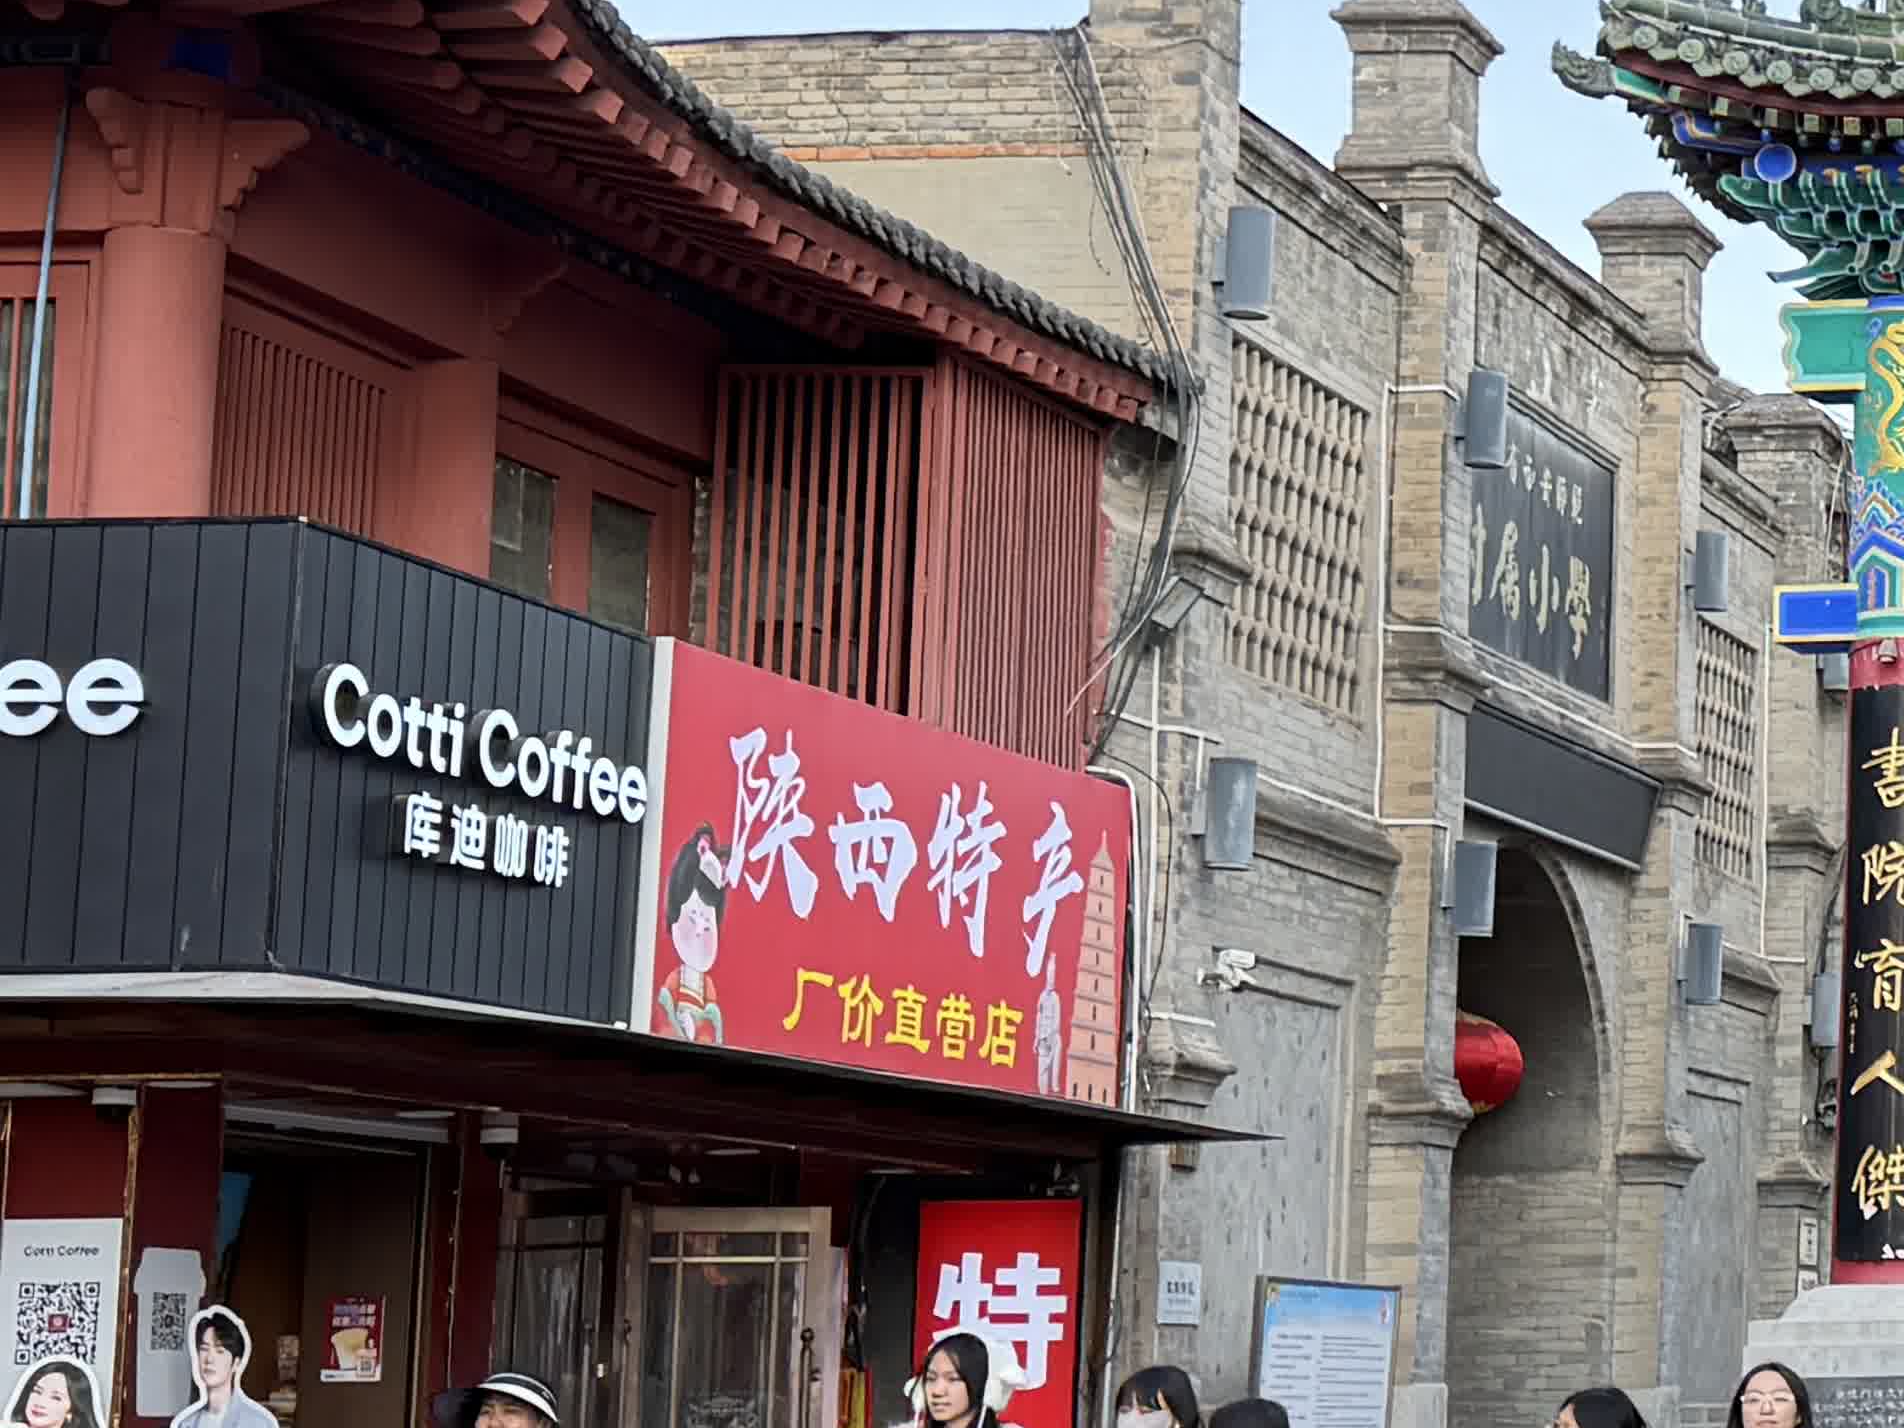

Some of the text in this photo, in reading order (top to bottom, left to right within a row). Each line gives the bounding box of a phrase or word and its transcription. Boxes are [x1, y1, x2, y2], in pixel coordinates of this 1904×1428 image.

[321, 662, 647, 825] Cotti Coffee
[403, 791, 569, 889] 库迪咖啡
[783, 969, 1024, 1069] 厂价直营店
[934, 1252, 1067, 1390] 特
